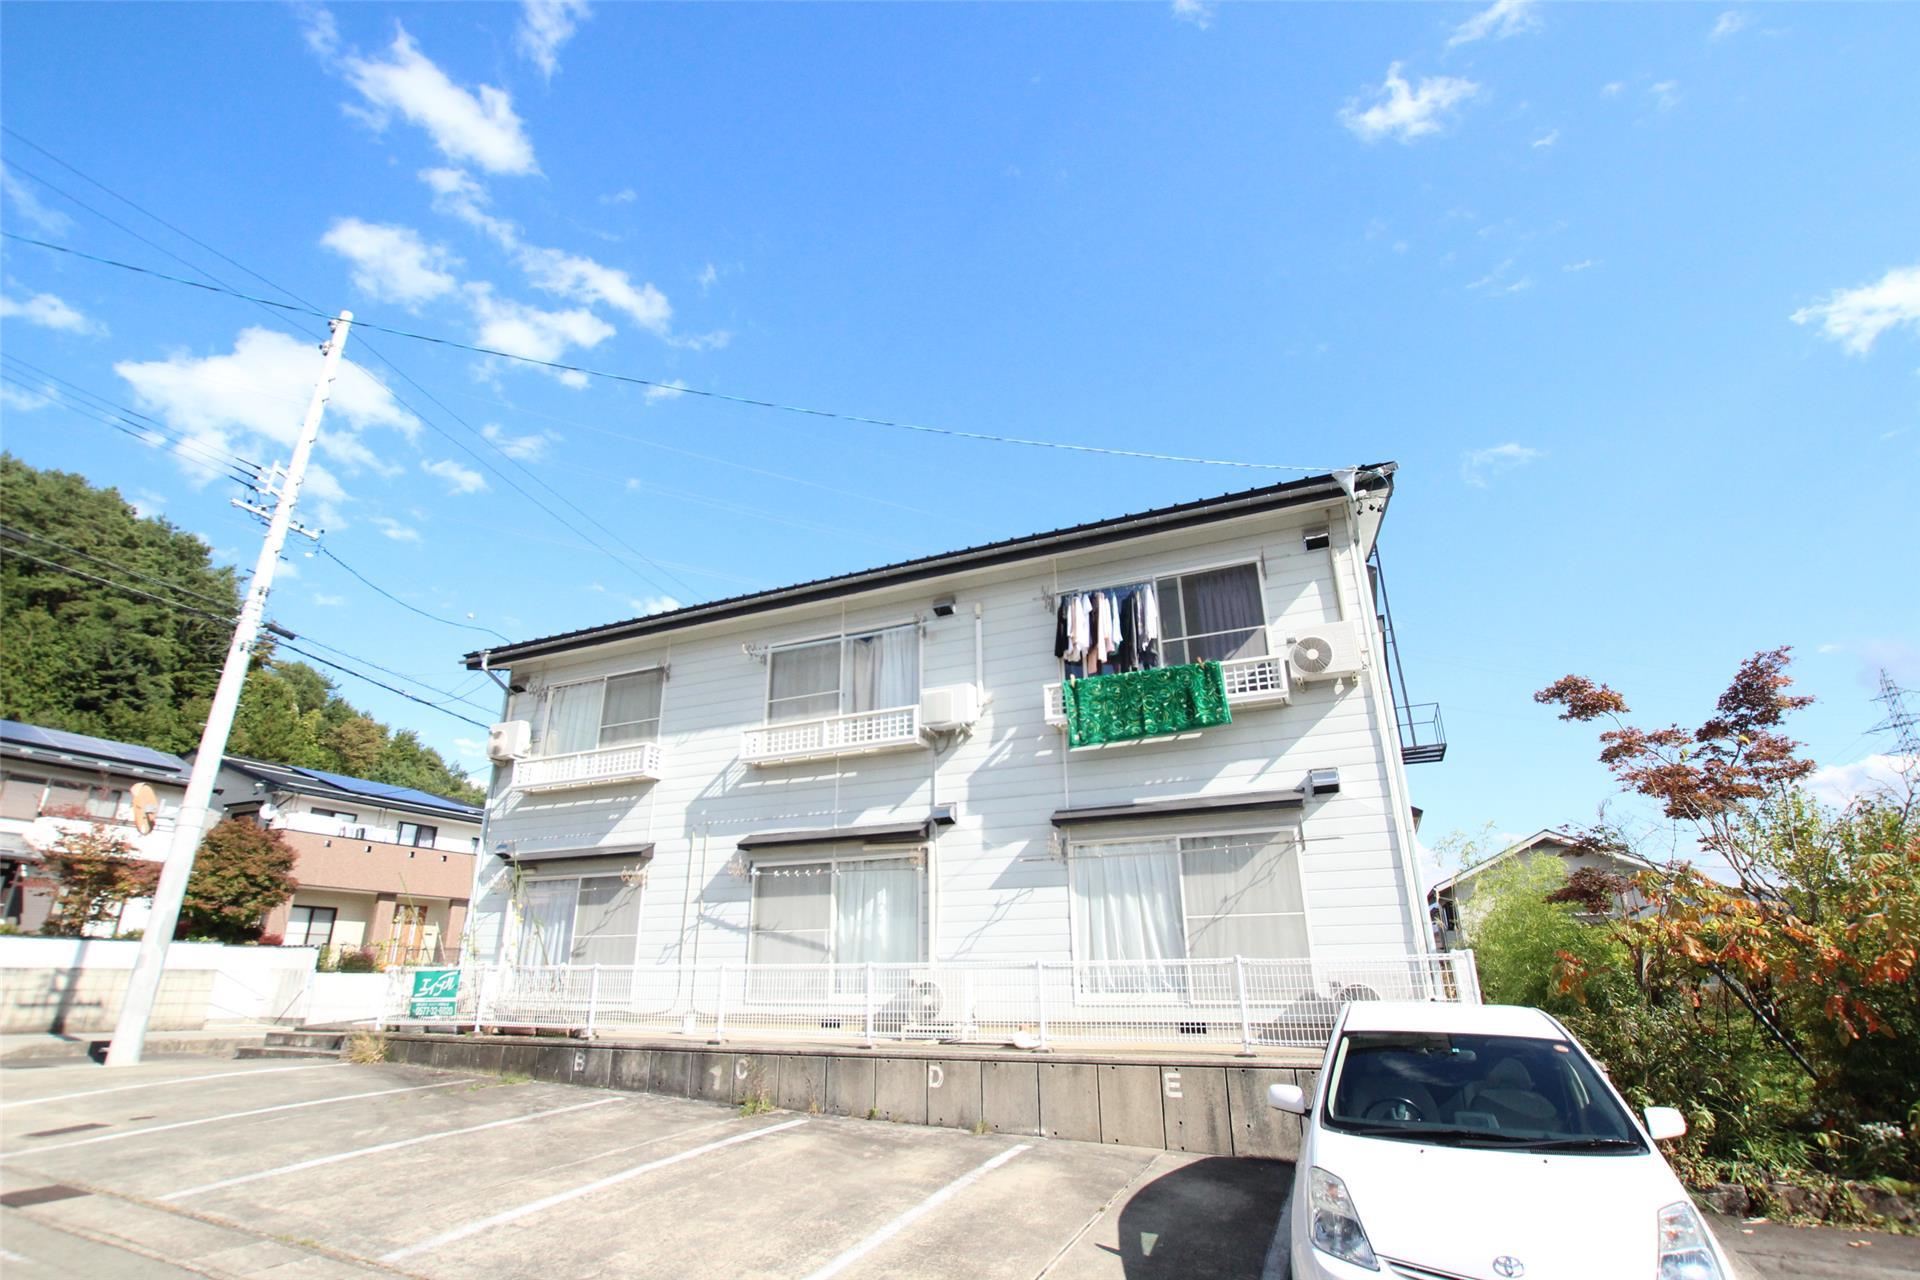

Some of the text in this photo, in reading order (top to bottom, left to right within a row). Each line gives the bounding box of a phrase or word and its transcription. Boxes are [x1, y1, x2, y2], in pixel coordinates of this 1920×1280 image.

[574, 1052, 585, 1071] B
[928, 1065, 944, 1088] D
[1164, 1073, 1183, 1098] E
